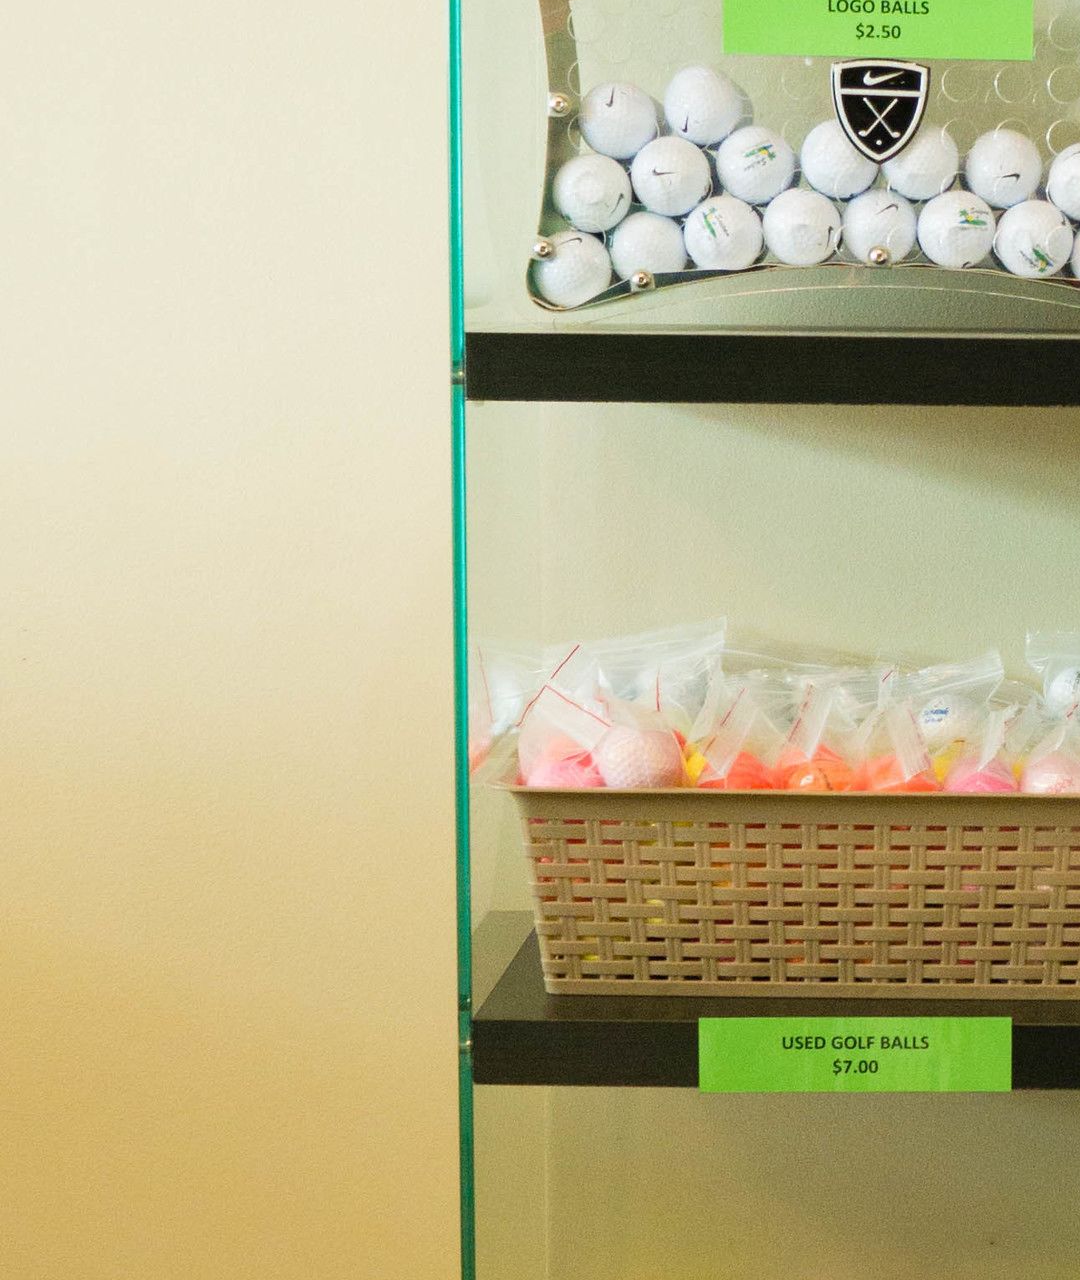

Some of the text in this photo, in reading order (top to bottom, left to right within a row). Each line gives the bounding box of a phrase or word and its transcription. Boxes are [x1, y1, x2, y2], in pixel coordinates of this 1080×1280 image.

[880, 0, 931, 16] BALLS
[855, 22, 902, 40] $2.50
[781, 1035, 931, 1051] USED GOLF BALLS
[832, 1058, 880, 1076] $7.00
